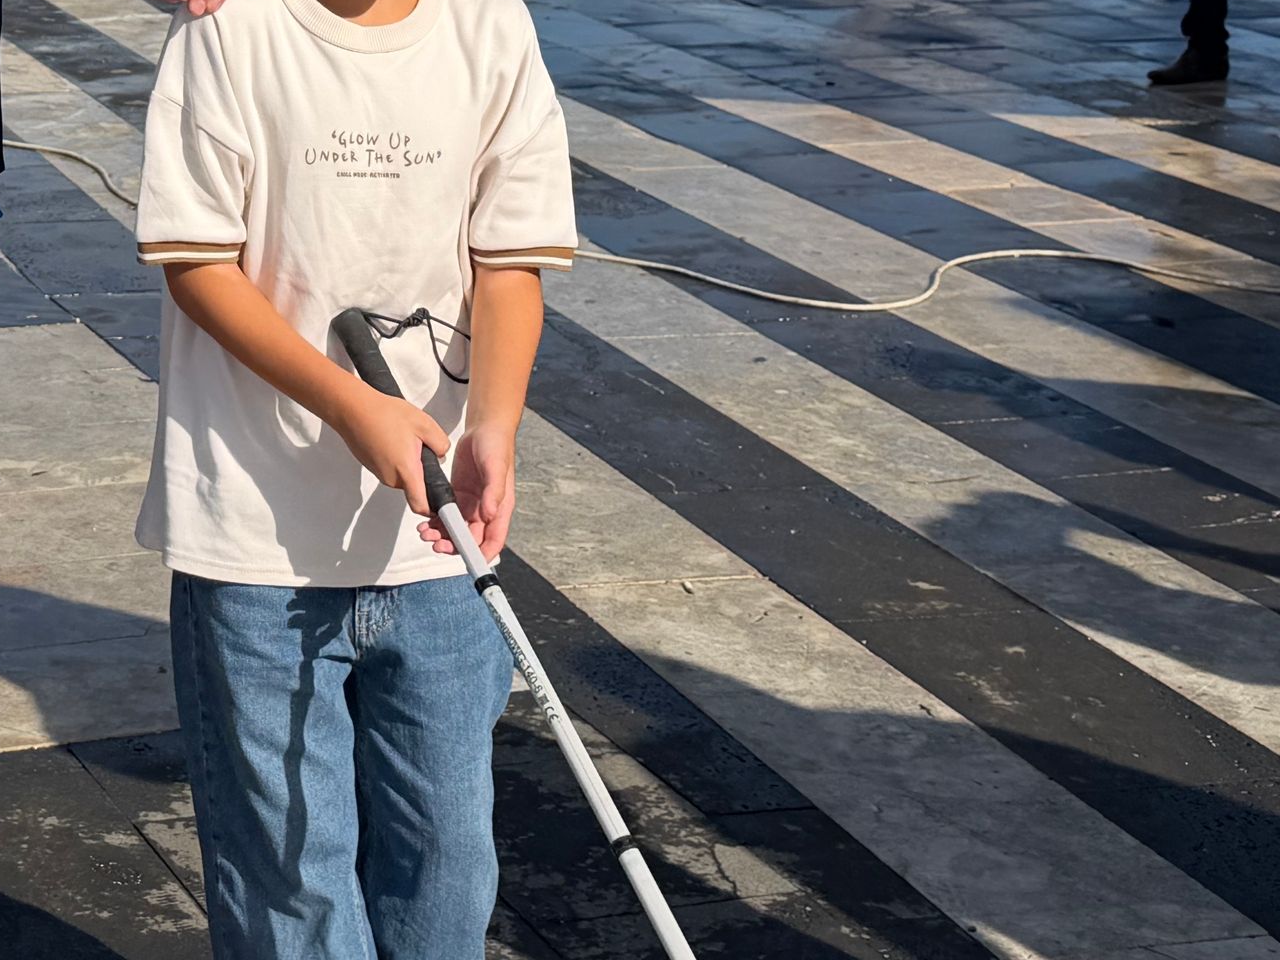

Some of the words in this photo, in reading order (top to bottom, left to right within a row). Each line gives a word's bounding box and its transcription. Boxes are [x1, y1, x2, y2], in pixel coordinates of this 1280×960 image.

[389, 132, 411, 150] UP
[305, 148, 358, 166] UNDER
[365, 148, 394, 168] THE
